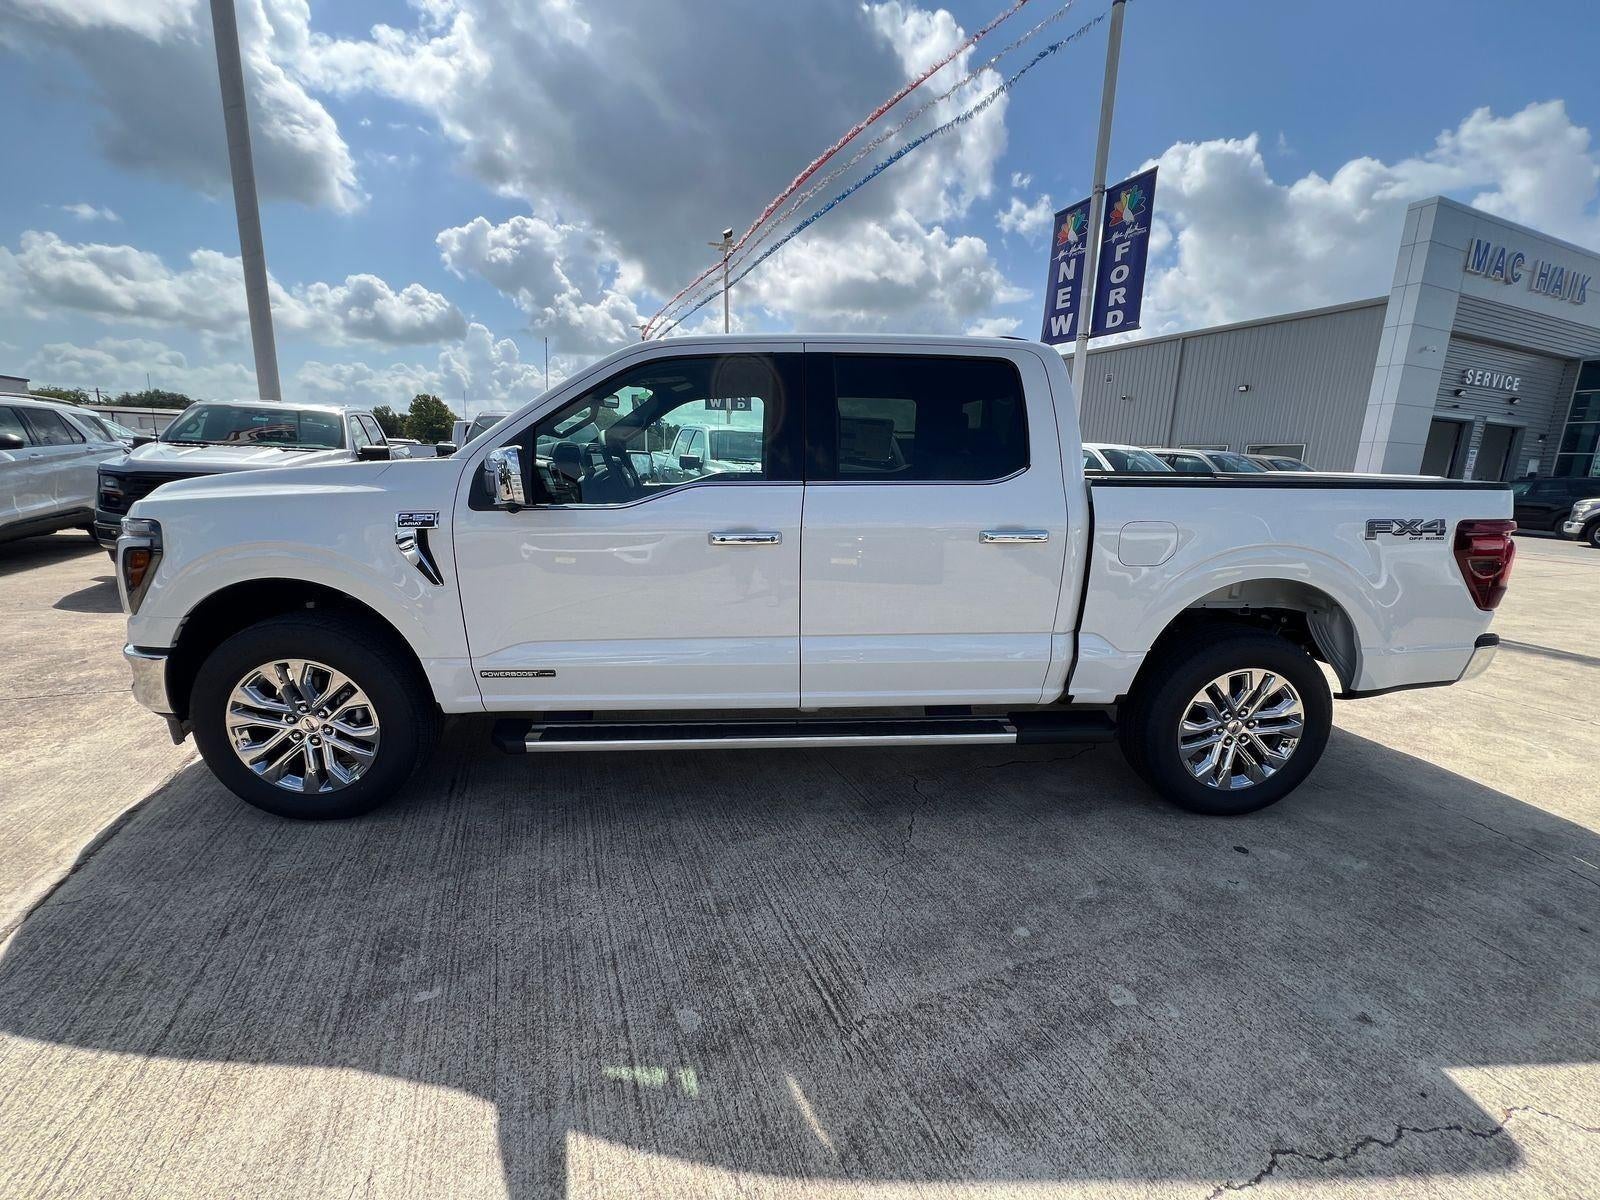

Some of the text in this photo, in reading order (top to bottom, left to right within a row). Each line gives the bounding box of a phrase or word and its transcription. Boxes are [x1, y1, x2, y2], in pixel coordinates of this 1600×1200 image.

[1105, 241, 1131, 329] FORD
[1468, 238, 1592, 303] MAC HAIK
[1050, 258, 1076, 337] NEW
[1466, 369, 1520, 391] SERVICE
[399, 513, 435, 521] F-150
[1365, 519, 1446, 540] FX4
